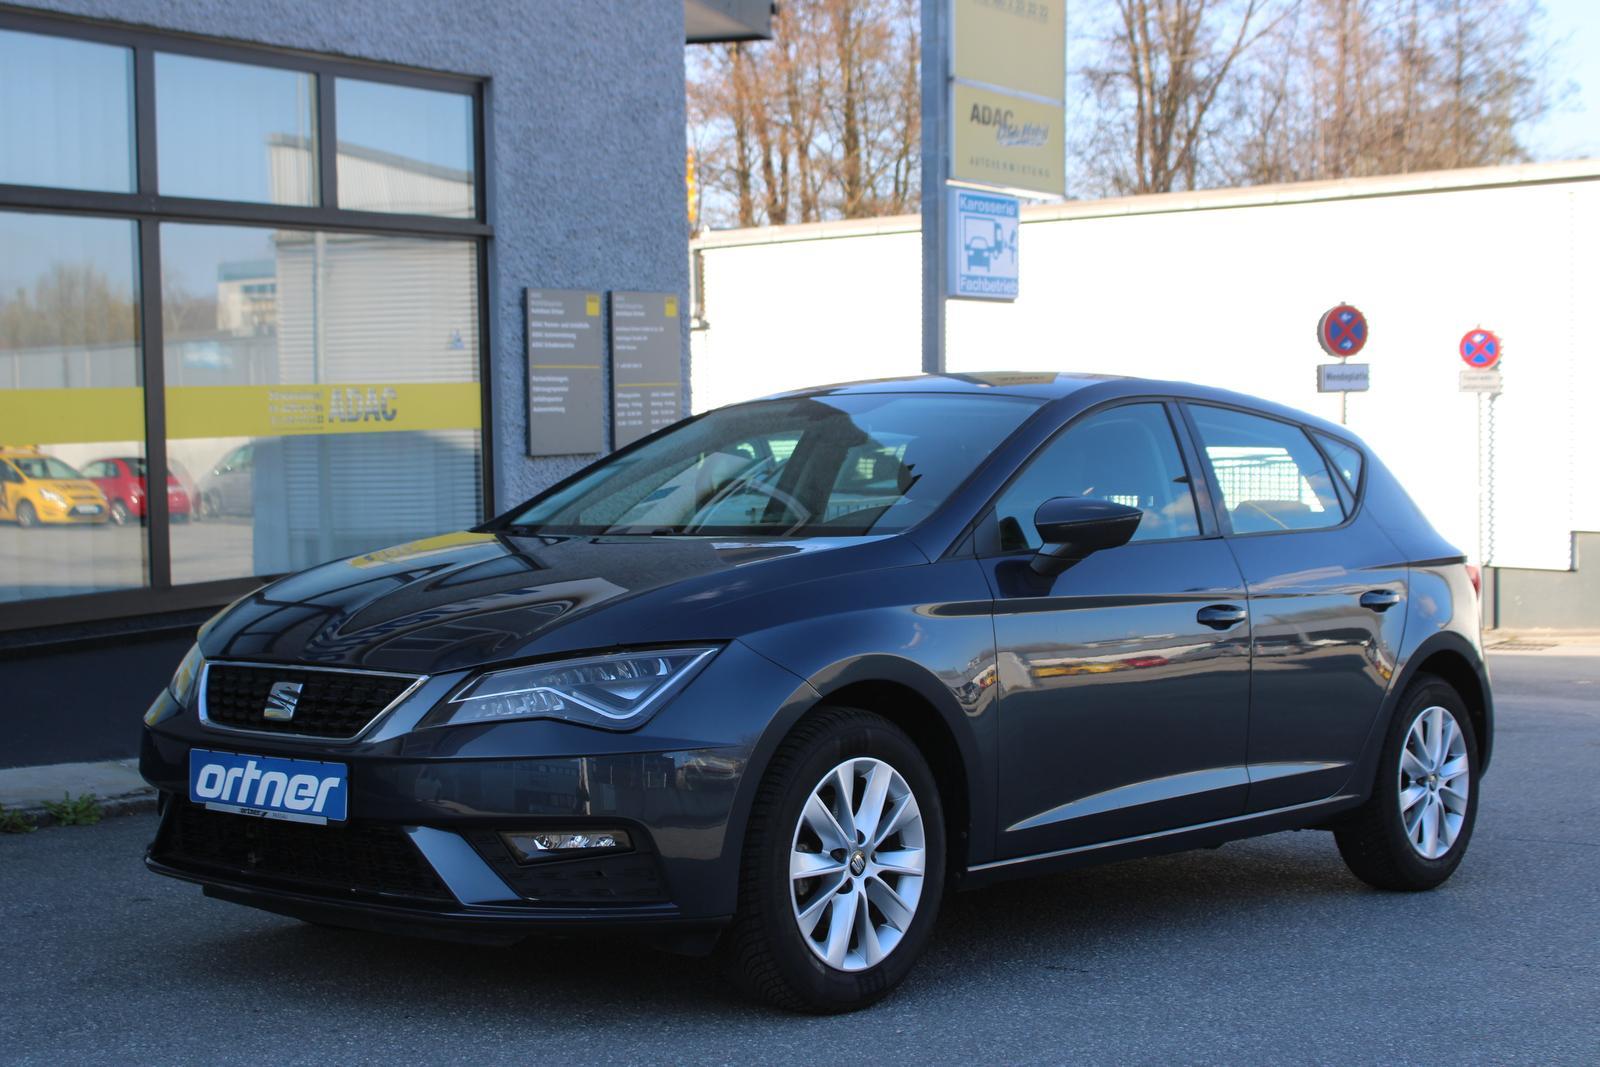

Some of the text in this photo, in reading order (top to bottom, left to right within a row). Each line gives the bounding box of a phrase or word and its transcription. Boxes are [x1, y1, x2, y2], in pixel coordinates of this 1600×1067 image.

[970, 103, 1014, 128] ADAC
[961, 196, 1016, 215] Karosserie
[960, 277, 1018, 295] Fachbetrieb
[328, 386, 398, 423] ADAC
[196, 760, 340, 812] ortner
